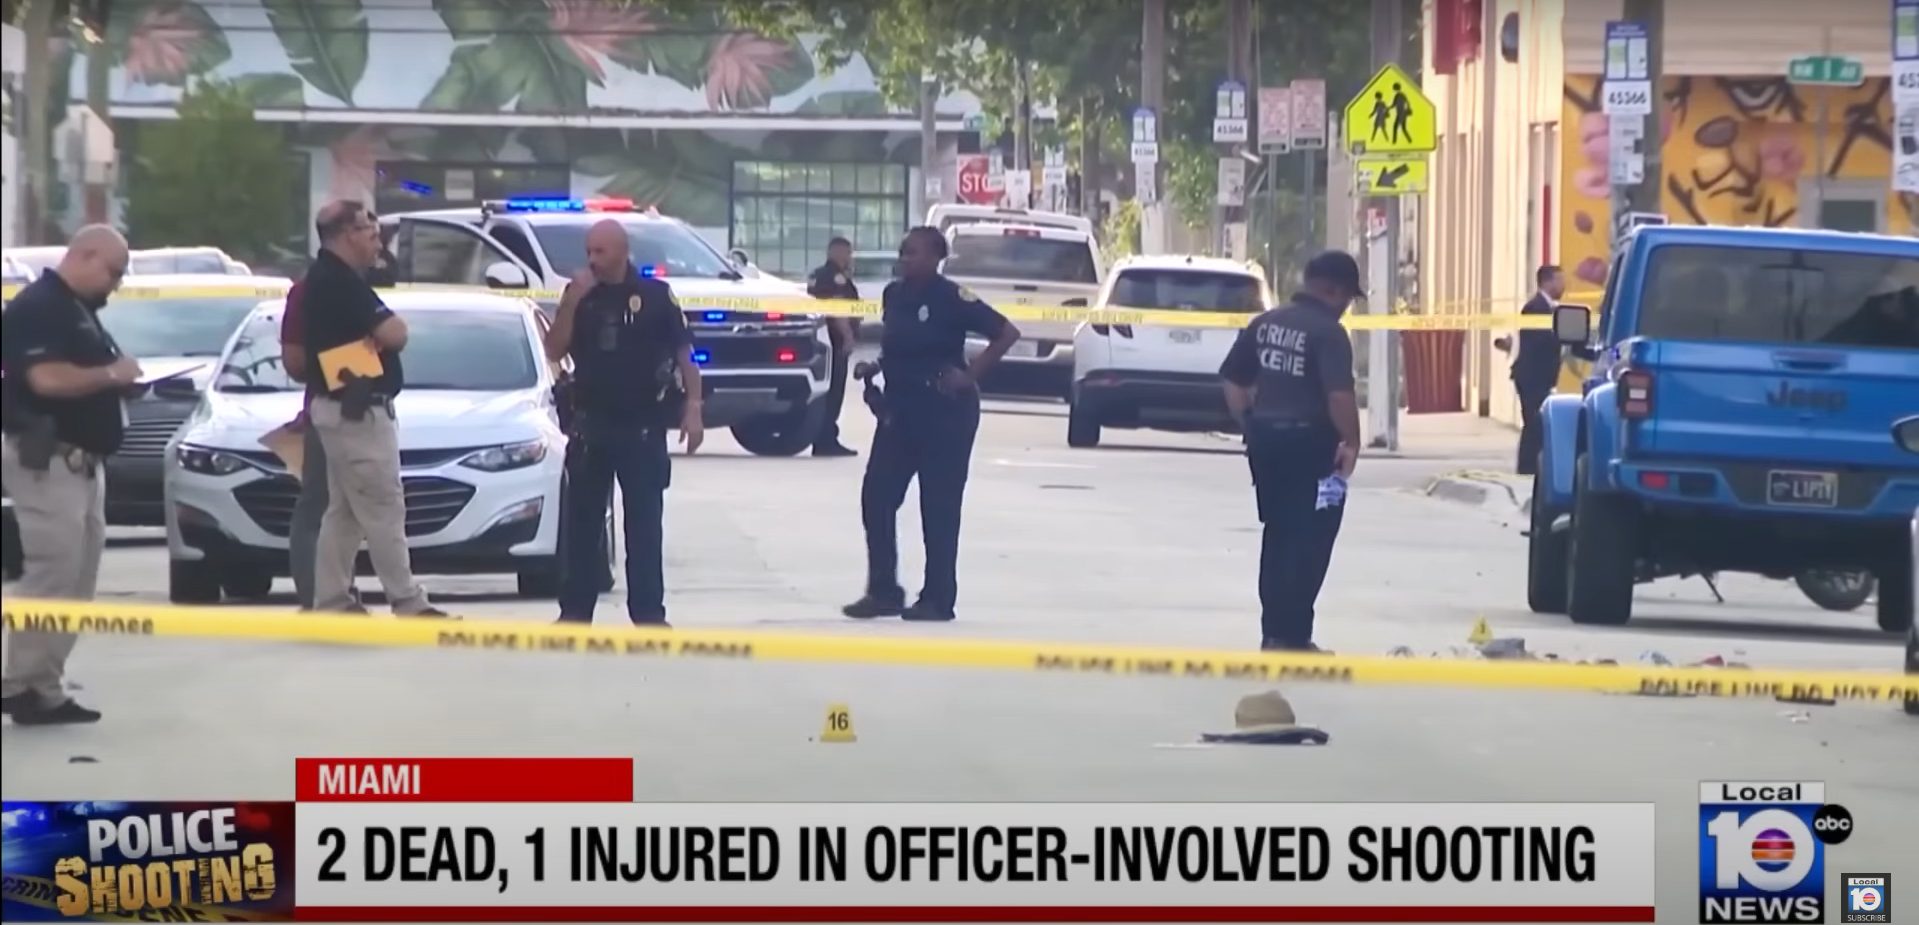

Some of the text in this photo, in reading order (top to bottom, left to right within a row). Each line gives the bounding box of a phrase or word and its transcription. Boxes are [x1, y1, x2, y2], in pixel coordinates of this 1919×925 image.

[1256, 323, 1307, 352] CRIME
[24, 612, 71, 633] NOT
[828, 711, 849, 731] 16
